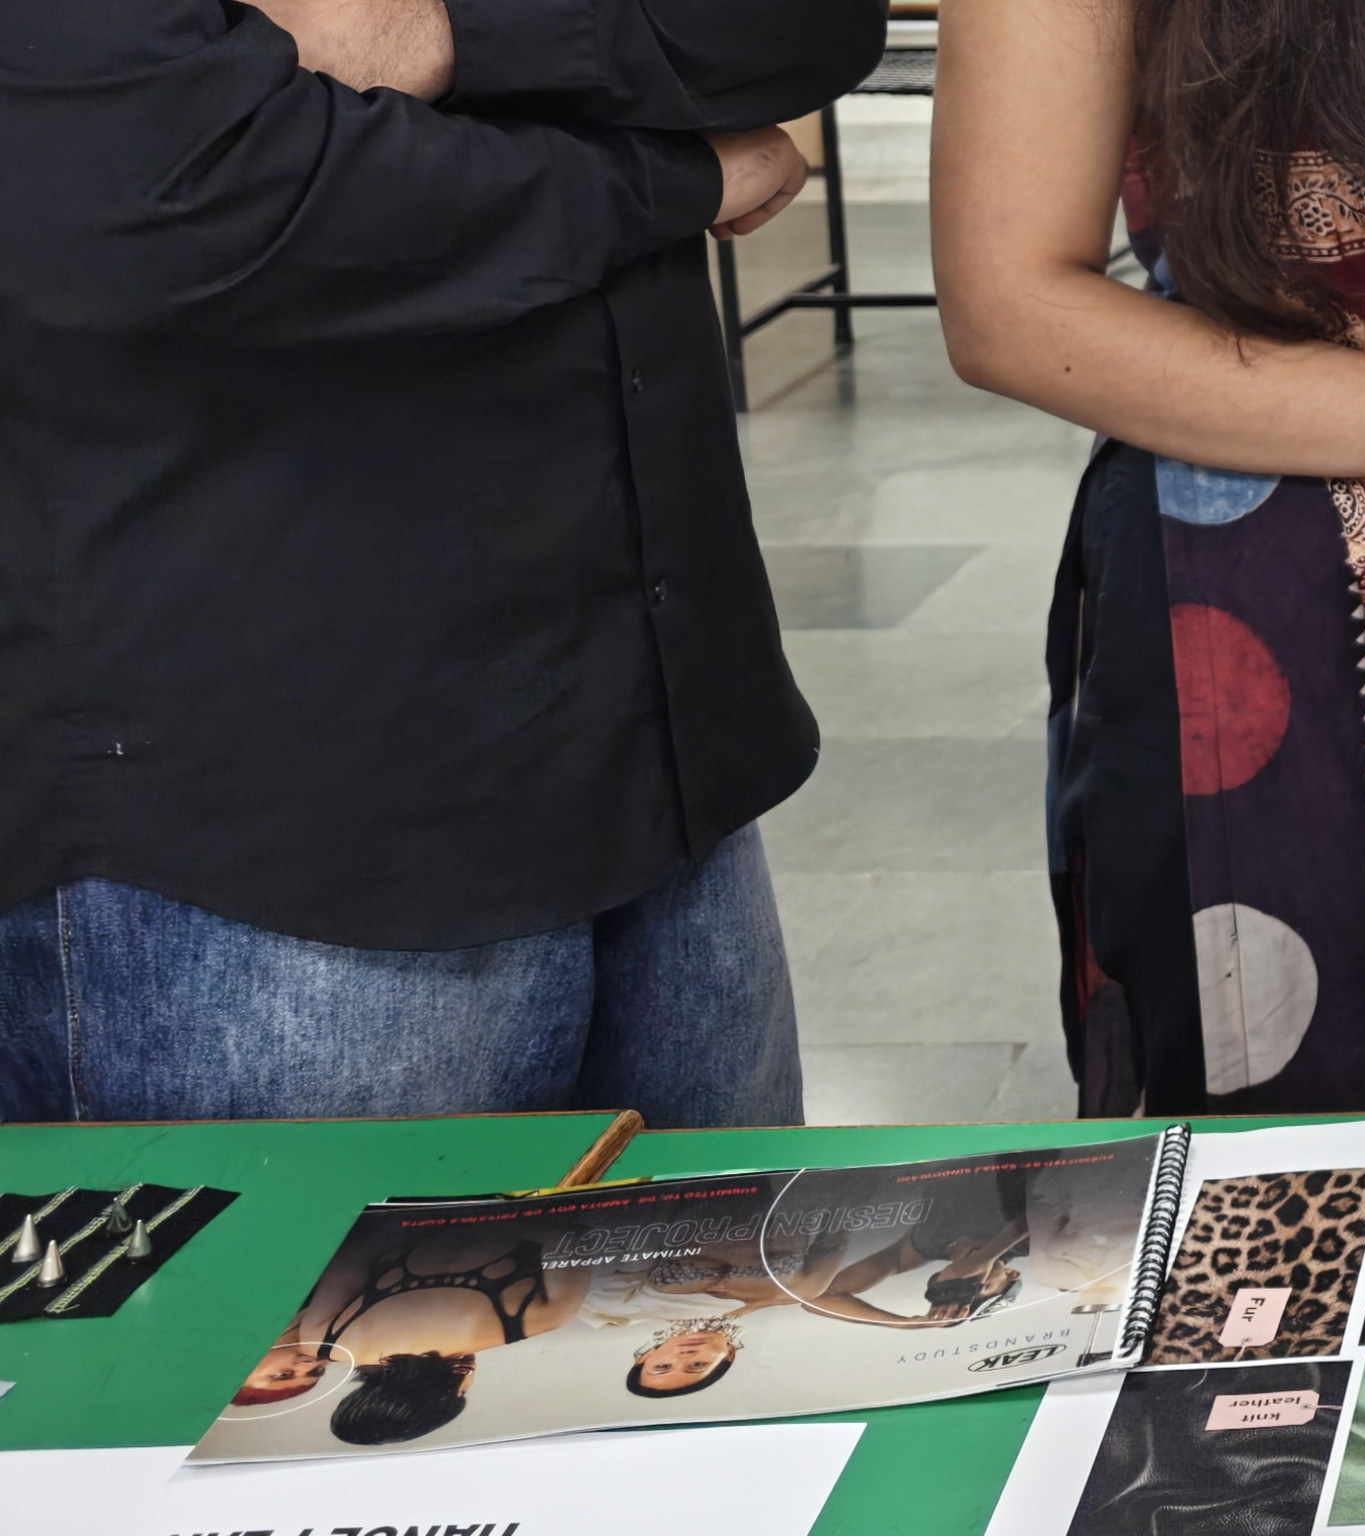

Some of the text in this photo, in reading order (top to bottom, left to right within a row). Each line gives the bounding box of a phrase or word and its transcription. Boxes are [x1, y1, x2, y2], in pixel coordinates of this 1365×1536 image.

[543, 1198, 934, 1259] DESIGN PROJECT
[541, 1247, 702, 1270] INTIMATE APPAREL
[1242, 1298, 1266, 1322] Fur
[896, 1328, 1070, 1364] BRANDSTUDY
[974, 1346, 1058, 1372] LEAK
[1228, 1396, 1300, 1408] leather
[1241, 1412, 1280, 1422] knit
